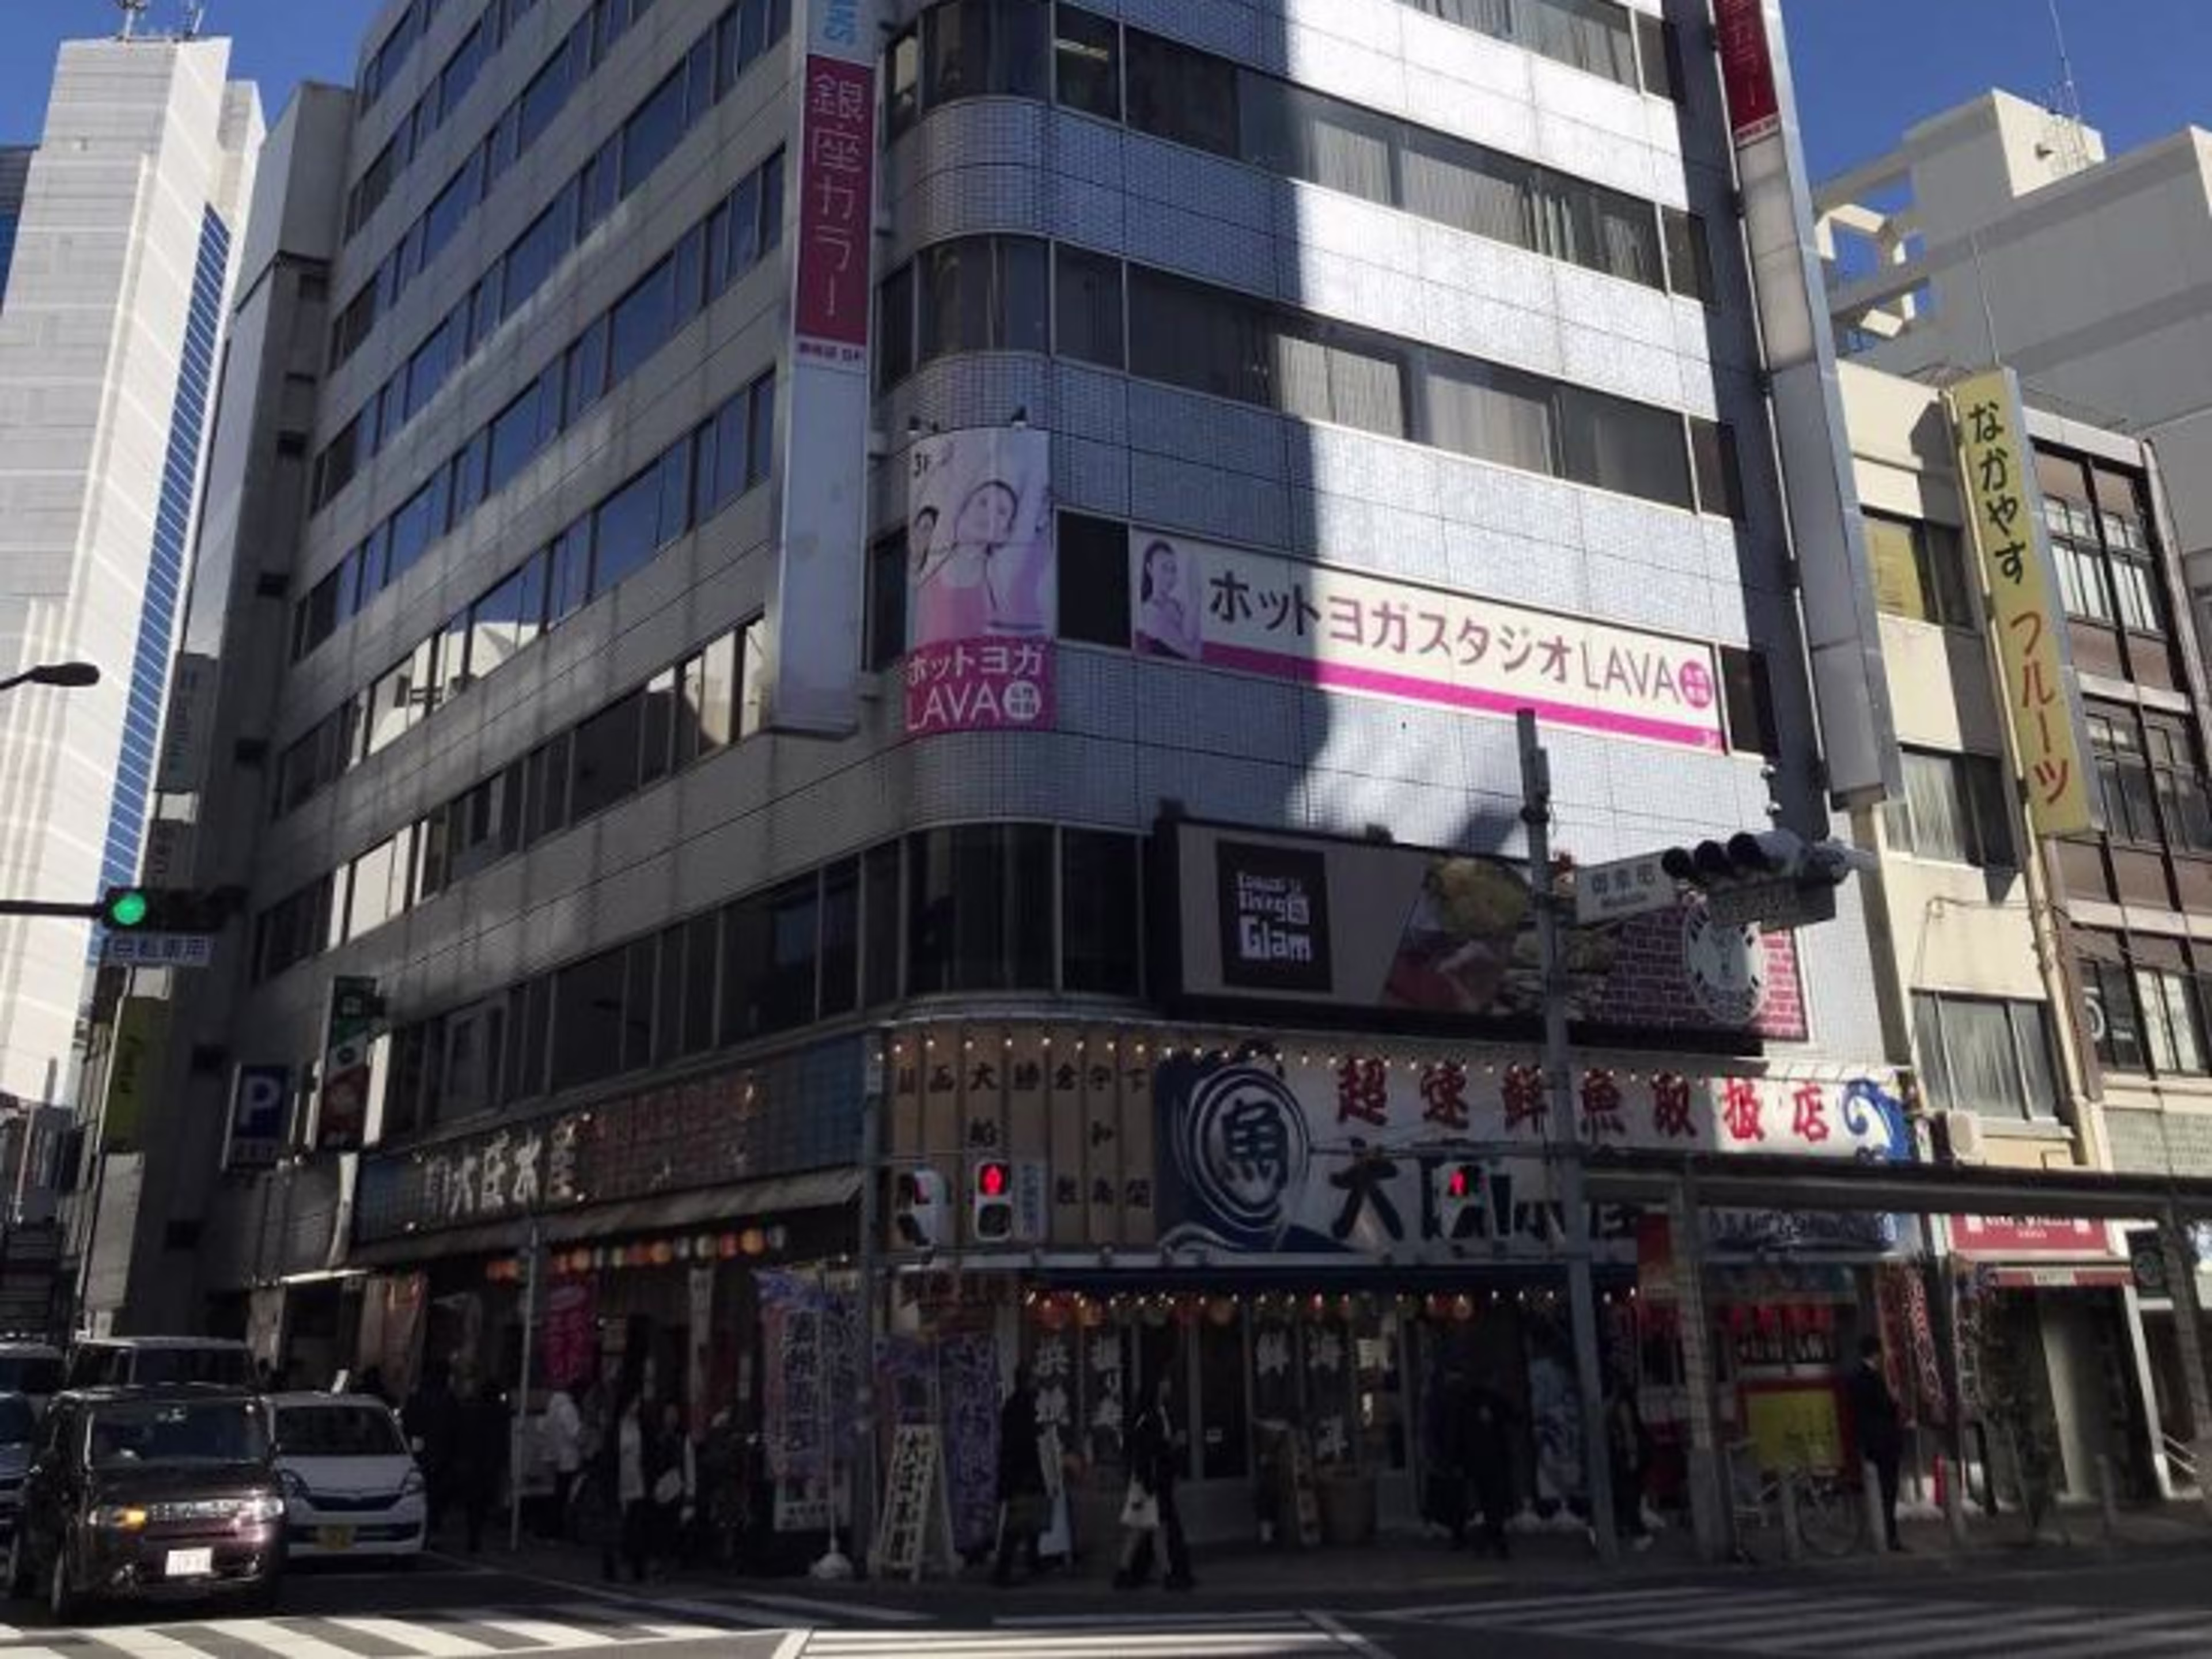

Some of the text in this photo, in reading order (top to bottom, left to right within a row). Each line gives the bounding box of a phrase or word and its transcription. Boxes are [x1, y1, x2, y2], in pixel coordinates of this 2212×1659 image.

[810, 74, 864, 317] 銀座カラー
[1968, 401, 2070, 805] なかやす フルーツ
[908, 642, 1045, 685] ホットヨガ
[907, 681, 1001, 729] LAVA
[1240, 916, 1312, 961] Glam
